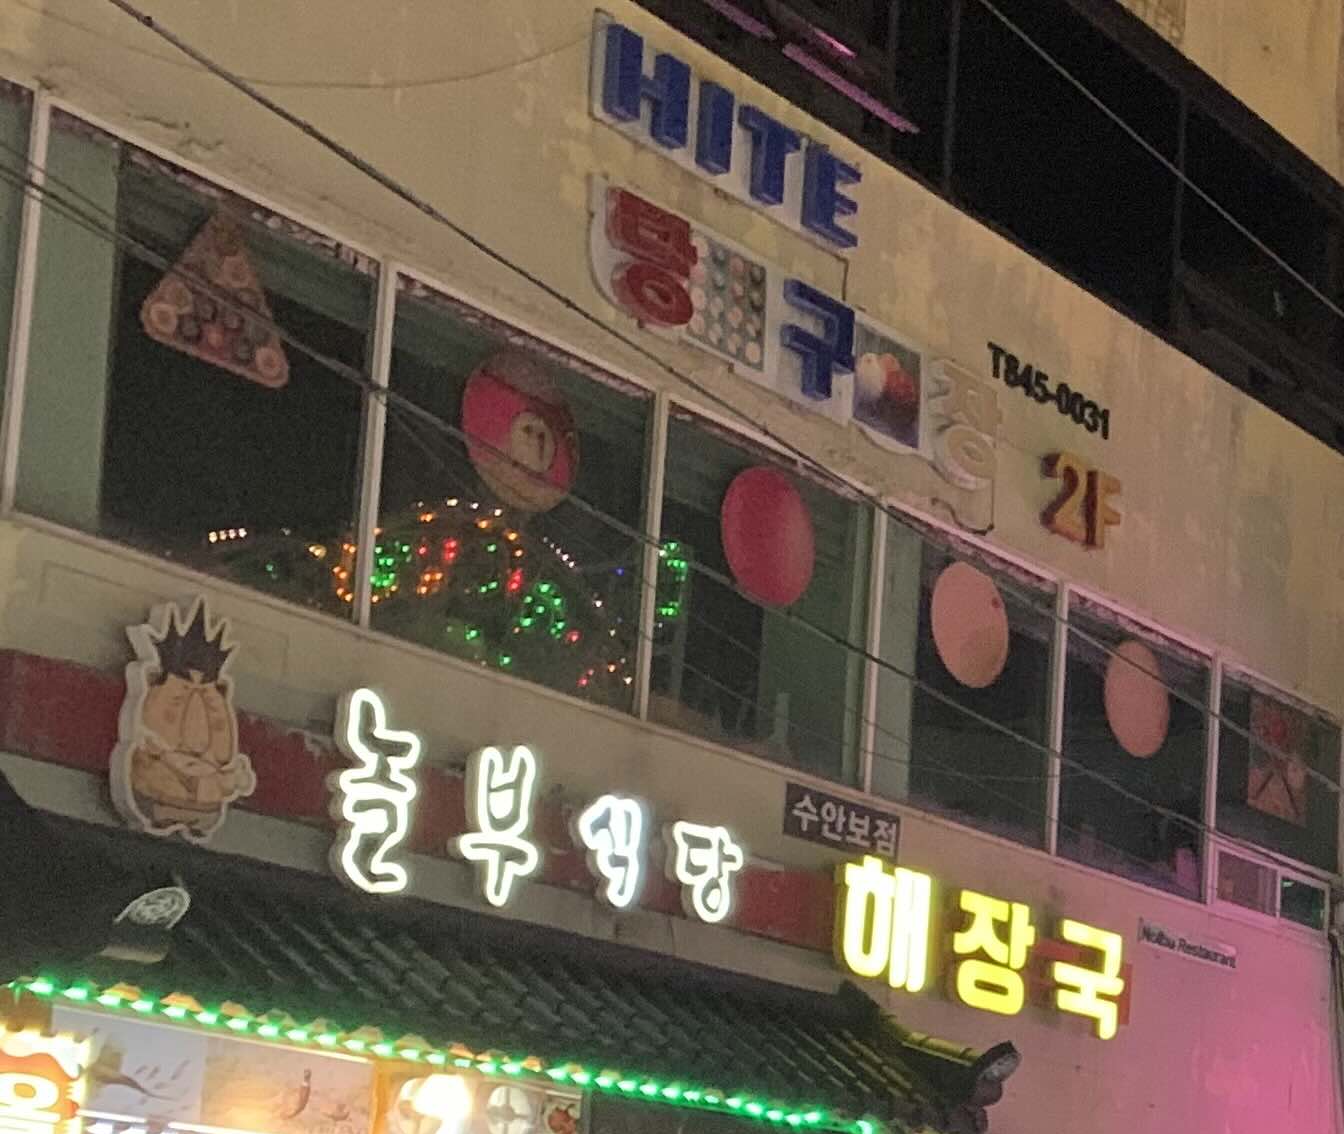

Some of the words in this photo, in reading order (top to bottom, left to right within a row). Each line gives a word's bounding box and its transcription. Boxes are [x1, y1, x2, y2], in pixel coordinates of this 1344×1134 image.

[602, 24, 862, 249] HITE
[987, 341, 1110, 440] T845-0031
[1040, 449, 1122, 548] 2F
[791, 793, 899, 858] 수안보점
[842, 854, 1126, 1041] 해장국
[1177, 937, 1237, 970] Restaurant
